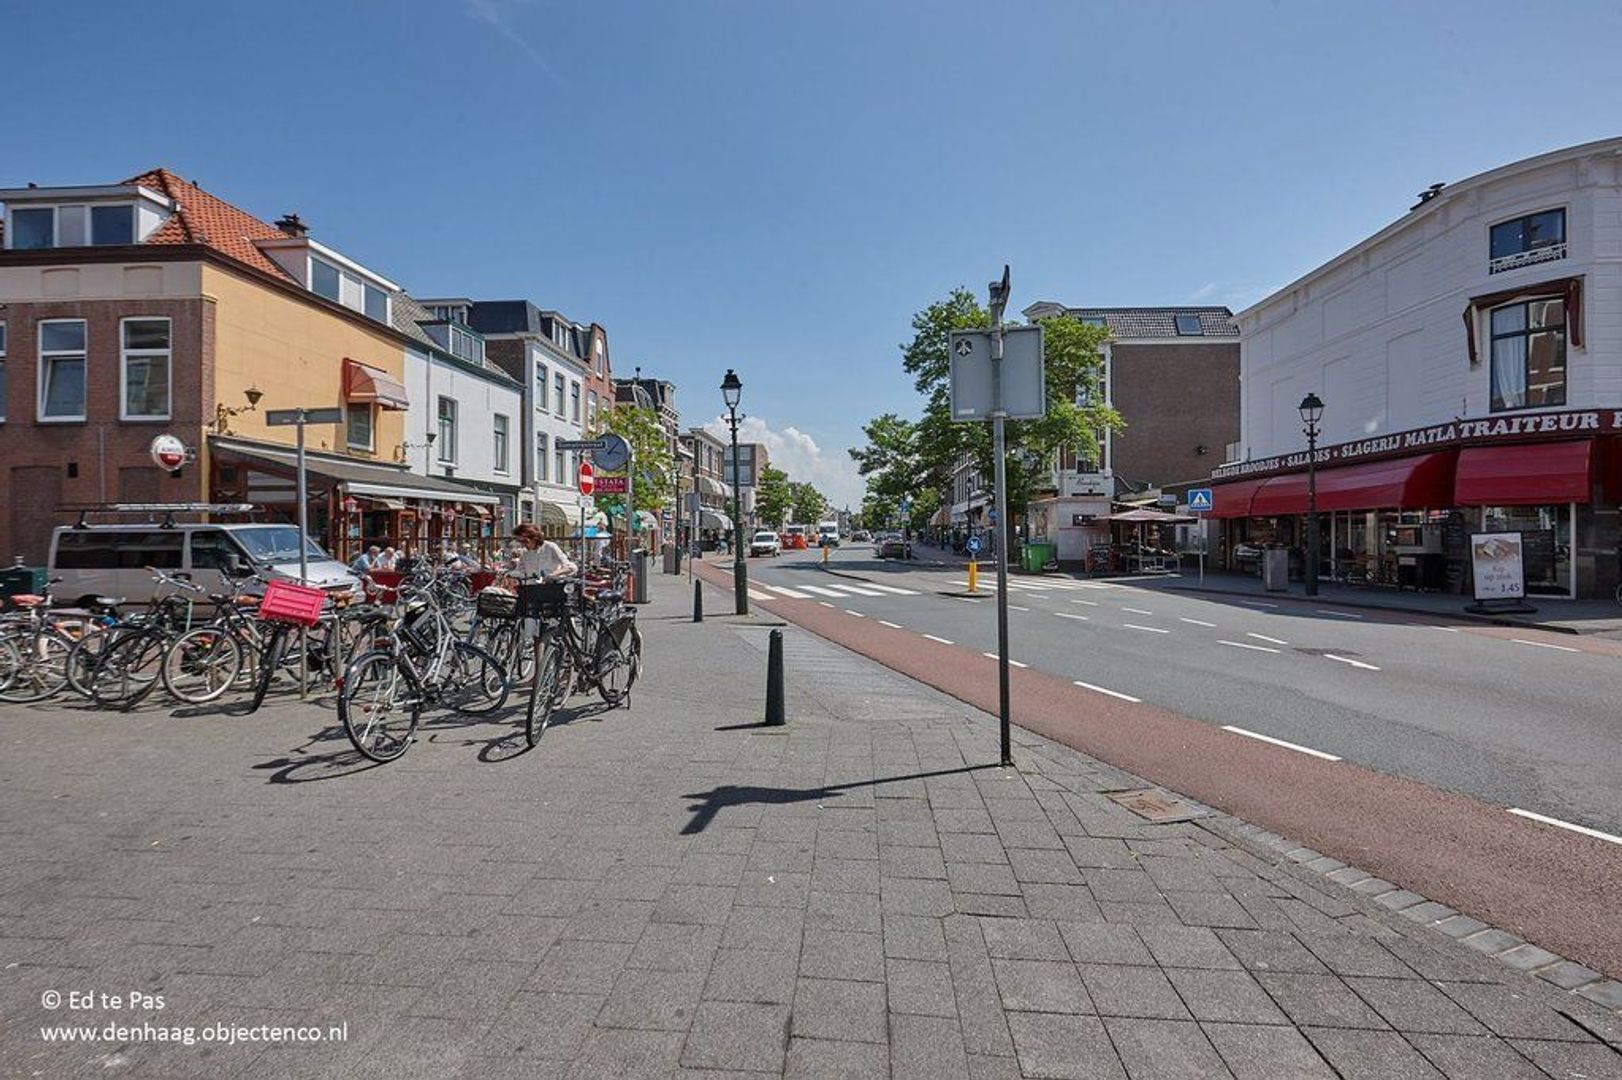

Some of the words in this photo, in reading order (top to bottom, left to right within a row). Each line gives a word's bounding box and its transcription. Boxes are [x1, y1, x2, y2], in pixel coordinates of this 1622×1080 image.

[1459, 412, 1600, 439] TRAITEUR
[1341, 434, 1401, 458] SLAGERIJ
[1404, 424, 1456, 448] MATLA
